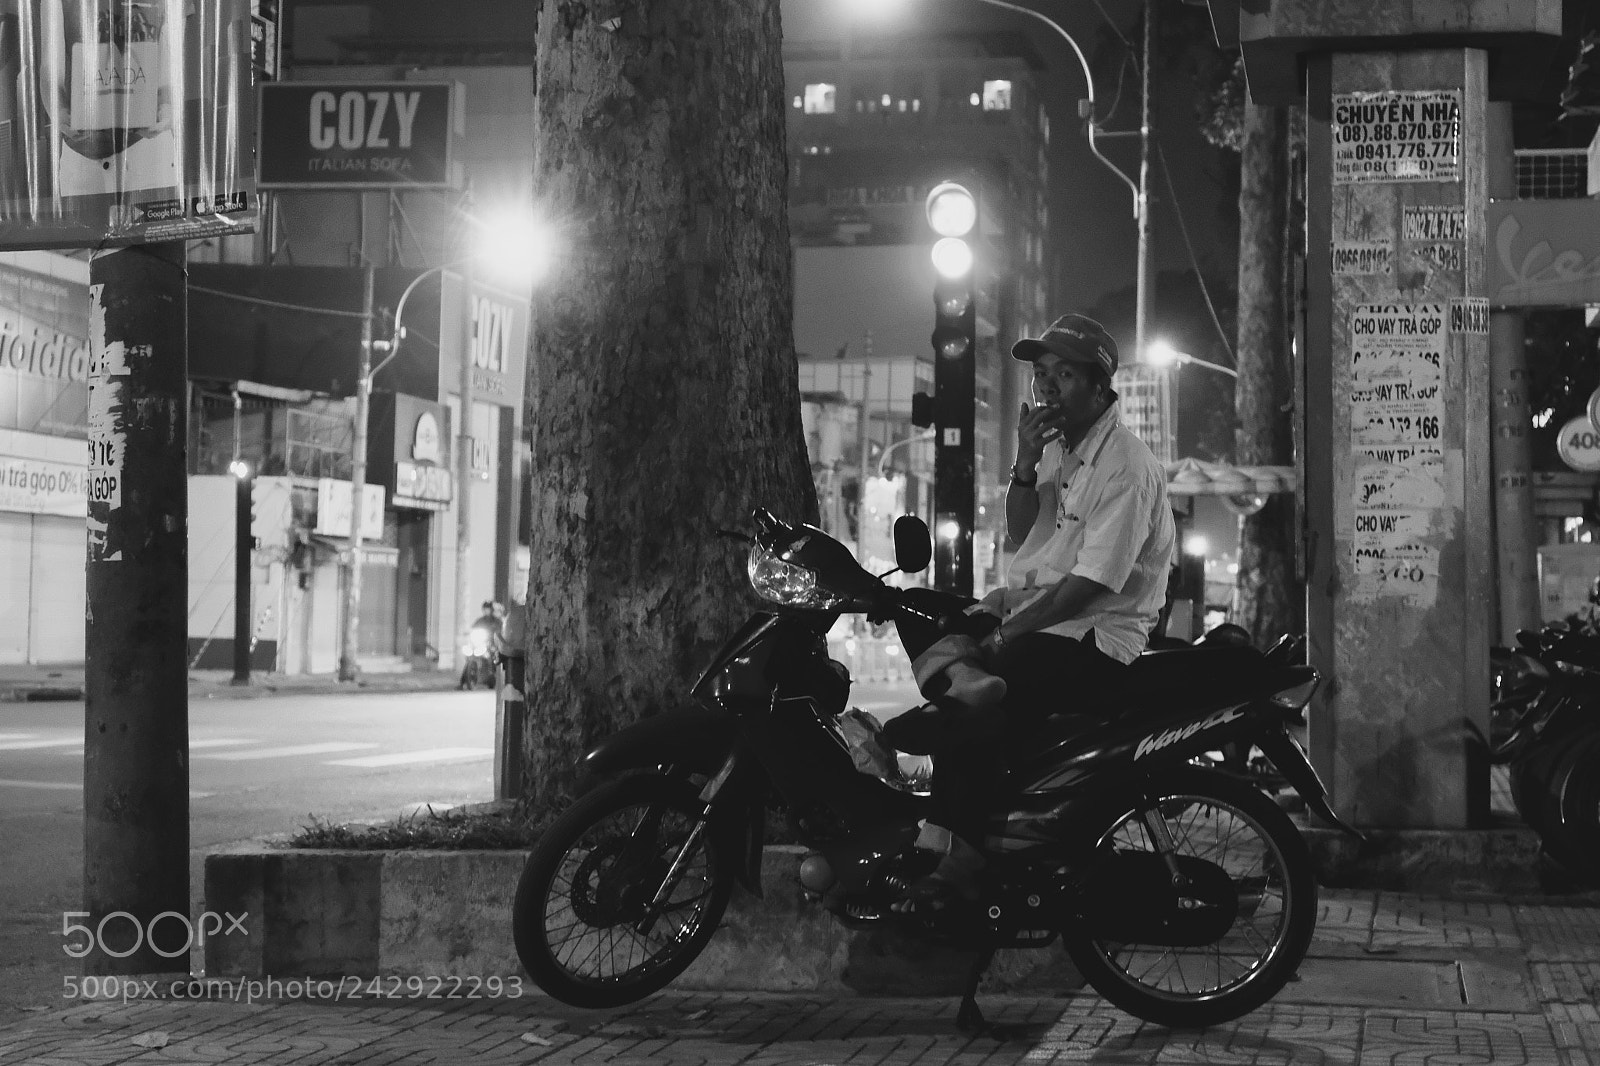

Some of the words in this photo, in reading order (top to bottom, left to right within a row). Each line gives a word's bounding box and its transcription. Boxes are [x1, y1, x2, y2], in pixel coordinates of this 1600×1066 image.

[309, 91, 421, 150] COZY
[308, 157, 366, 171] ITALIAN
[370, 157, 412, 171] SOFA
[147, 209, 170, 219] Google
[171, 208, 184, 217] Play
[225, 201, 244, 211] Store
[1354, 318, 1375, 335] CHO
[1378, 318, 1396, 335] VAY
[1420, 314, 1441, 335] GÓP
[1375, 384, 1392, 401] VAY
[30, 466, 56, 496] góp
[94, 471, 117, 500] GÓP
[1356, 515, 1377, 532] CHO
[1380, 515, 1398, 532] VAY
